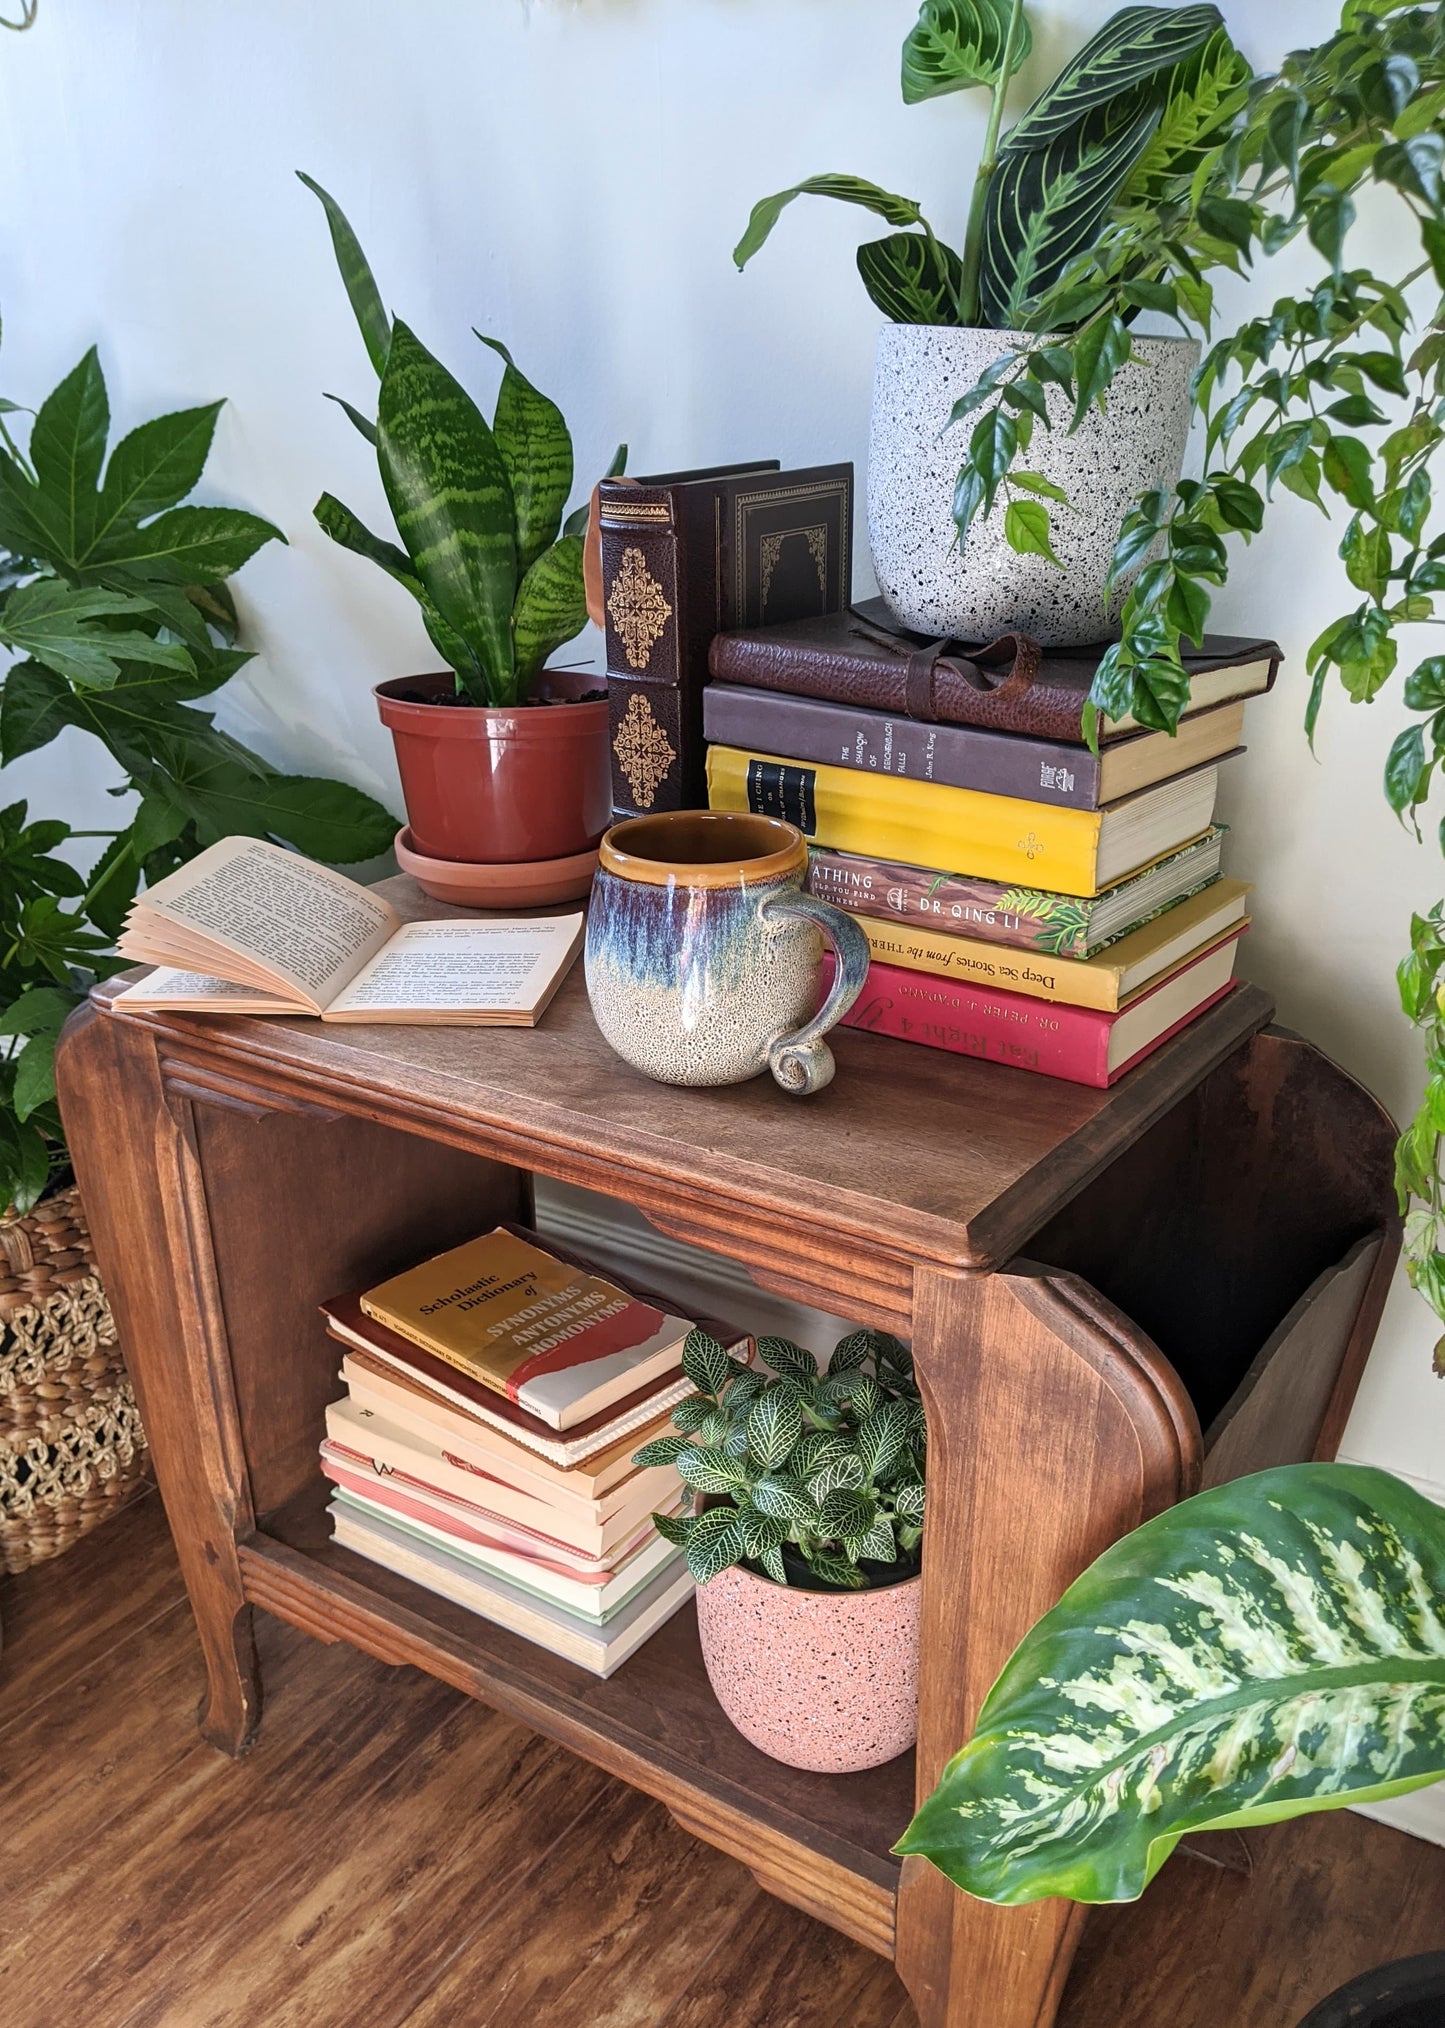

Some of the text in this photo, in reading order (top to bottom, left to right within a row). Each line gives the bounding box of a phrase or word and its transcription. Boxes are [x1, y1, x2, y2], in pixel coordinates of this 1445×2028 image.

[855, 731, 867, 765] SHADOW
[927, 732, 937, 751] King
[841, 746, 850, 760] THE
[869, 754, 877, 767] OF
[897, 752, 906, 773] FALLS
[755, 764, 764, 795] CHING
[925, 761, 934, 779] John
[778, 767, 786, 799] CHANGES
[767, 791, 773, 801] OR
[812, 865, 873, 889] ATHING
[814, 881, 876, 900] ELP YOU FIND
[816, 893, 859, 907] PPINESS
[920, 897, 1019, 930] DR. QING LI
[868, 938, 1056, 990] Deep Sea Stories from the THER
[967, 1000, 978, 1011] J.
[983, 1004, 1028, 1024] PETER
[1035, 1016, 1059, 1031] DR.
[901, 1017, 1039, 1067] Eat Right 4
[419, 1275, 500, 1315] Scholastic
[456, 1271, 538, 1312] Dictionary
[524, 1285, 537, 1296] of
[486, 1286, 582, 1338] SYNONYMS
[511, 1291, 607, 1346] ANTONYMS
[526, 1298, 630, 1356] HOMONYMS
